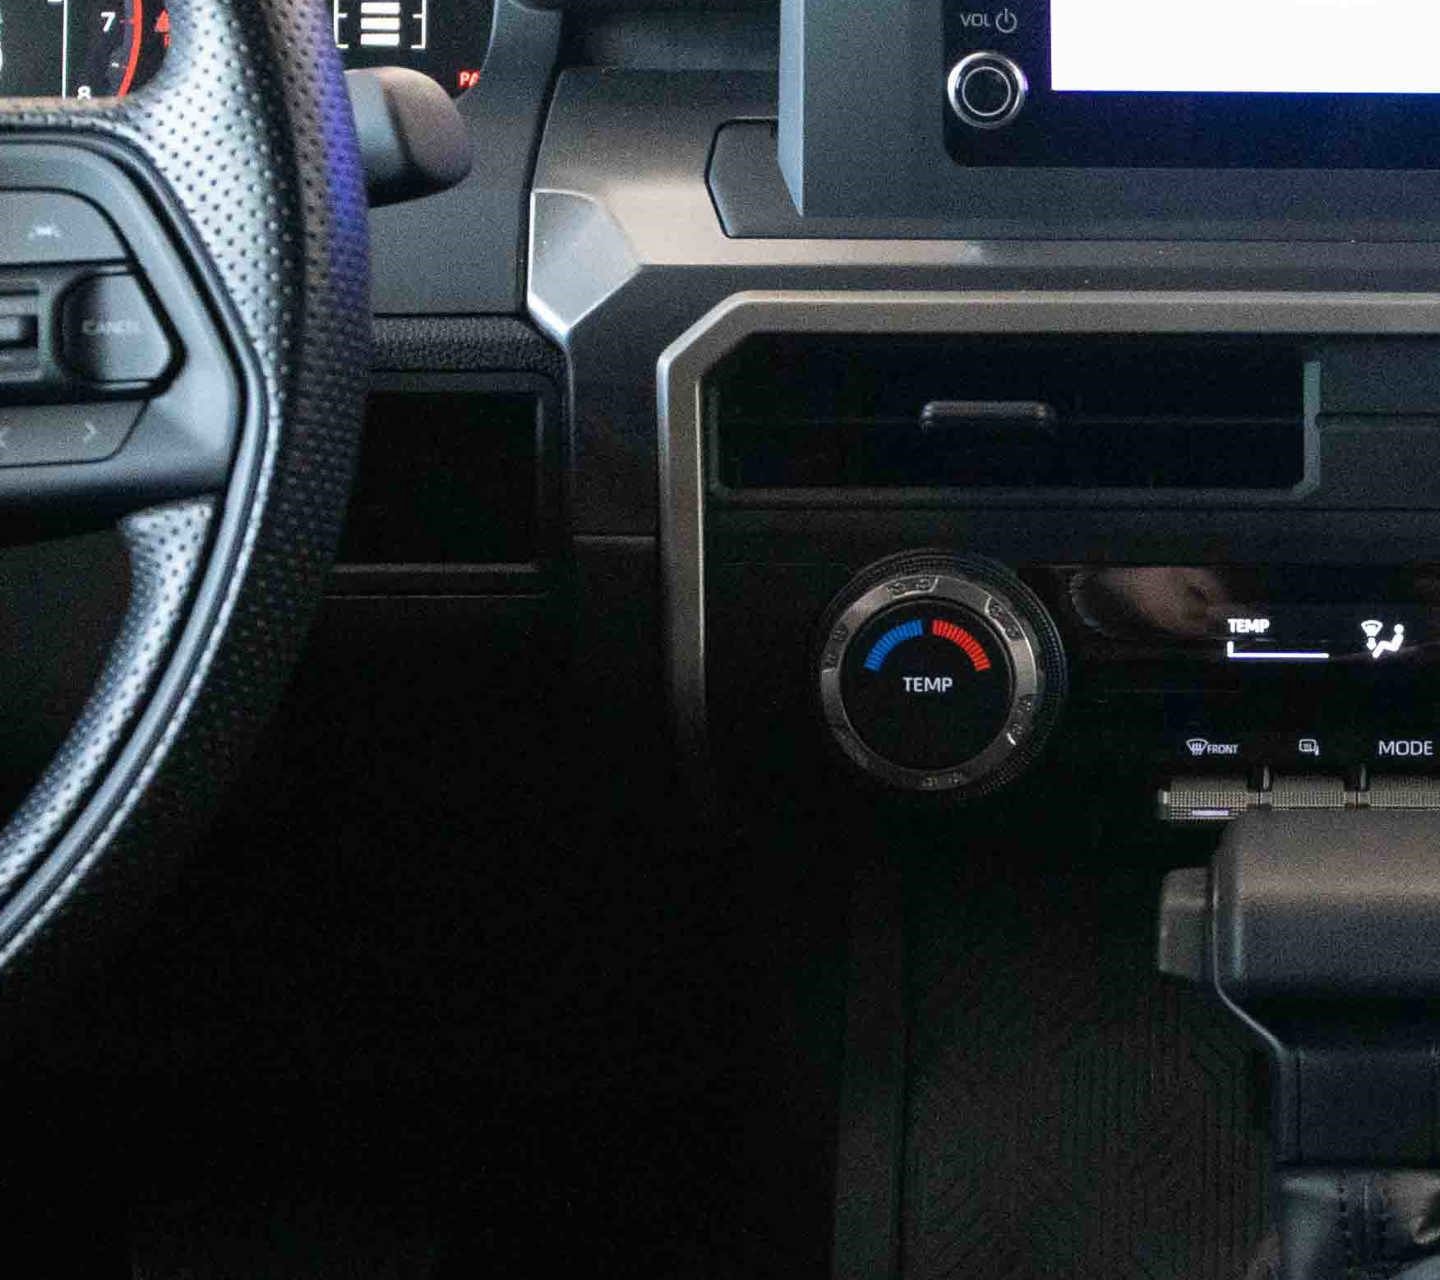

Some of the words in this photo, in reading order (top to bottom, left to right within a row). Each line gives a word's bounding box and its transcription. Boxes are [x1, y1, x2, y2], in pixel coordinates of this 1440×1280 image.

[99, 11, 115, 32] 7
[959, 13, 992, 27] VOL
[1227, 618, 1271, 634] TEMP
[902, 676, 953, 693] TEMP
[1206, 743, 1239, 755] FRONT
[1378, 739, 1433, 756] MODE
